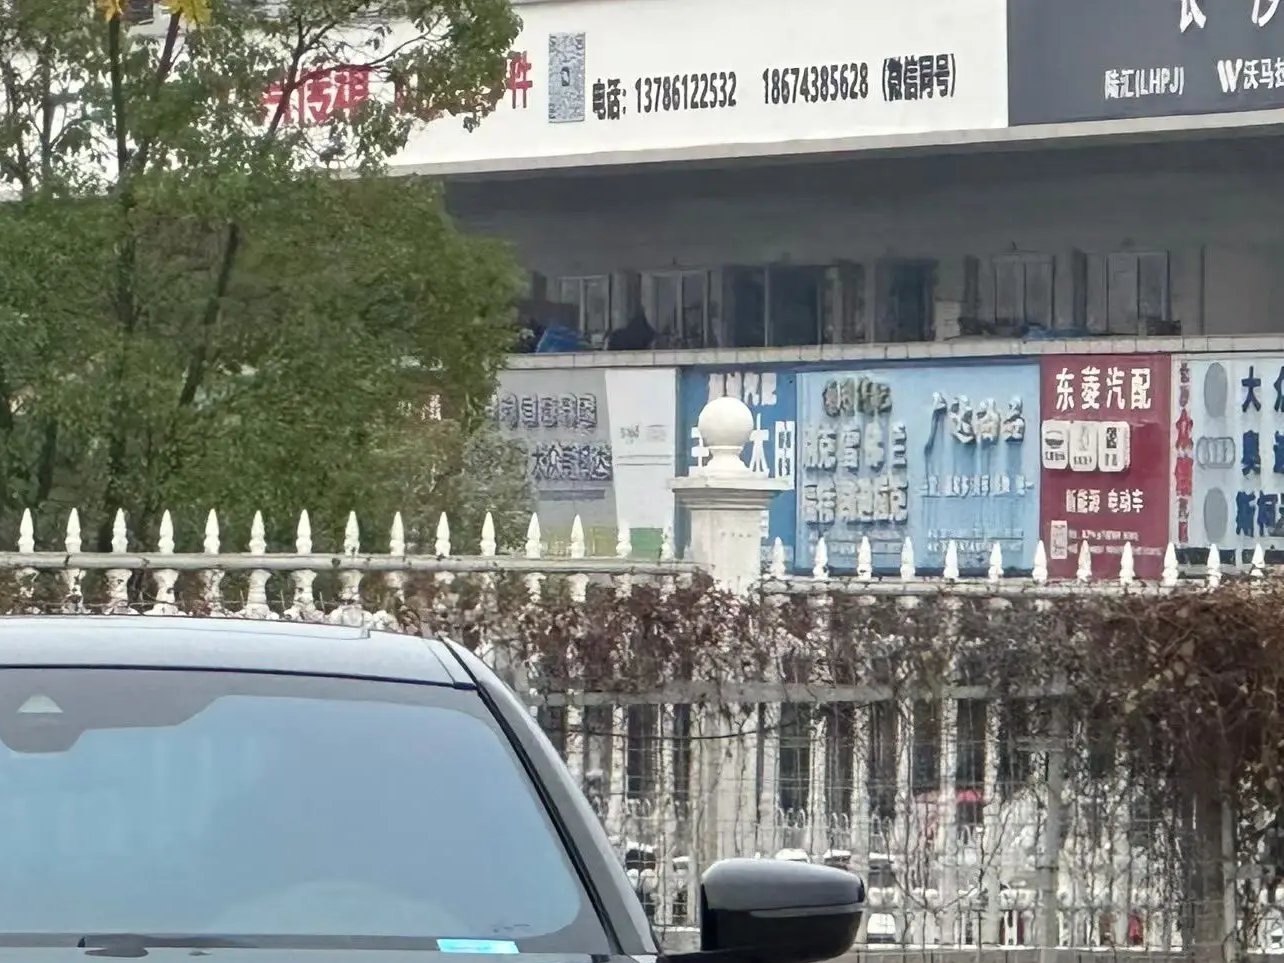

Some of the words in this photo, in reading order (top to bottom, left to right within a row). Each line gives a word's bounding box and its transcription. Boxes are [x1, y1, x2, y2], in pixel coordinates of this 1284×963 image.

[634, 71, 737, 114] 13786122532
[762, 62, 869, 105] 18674385628
[1055, 366, 1151, 411] 东菱汽配
